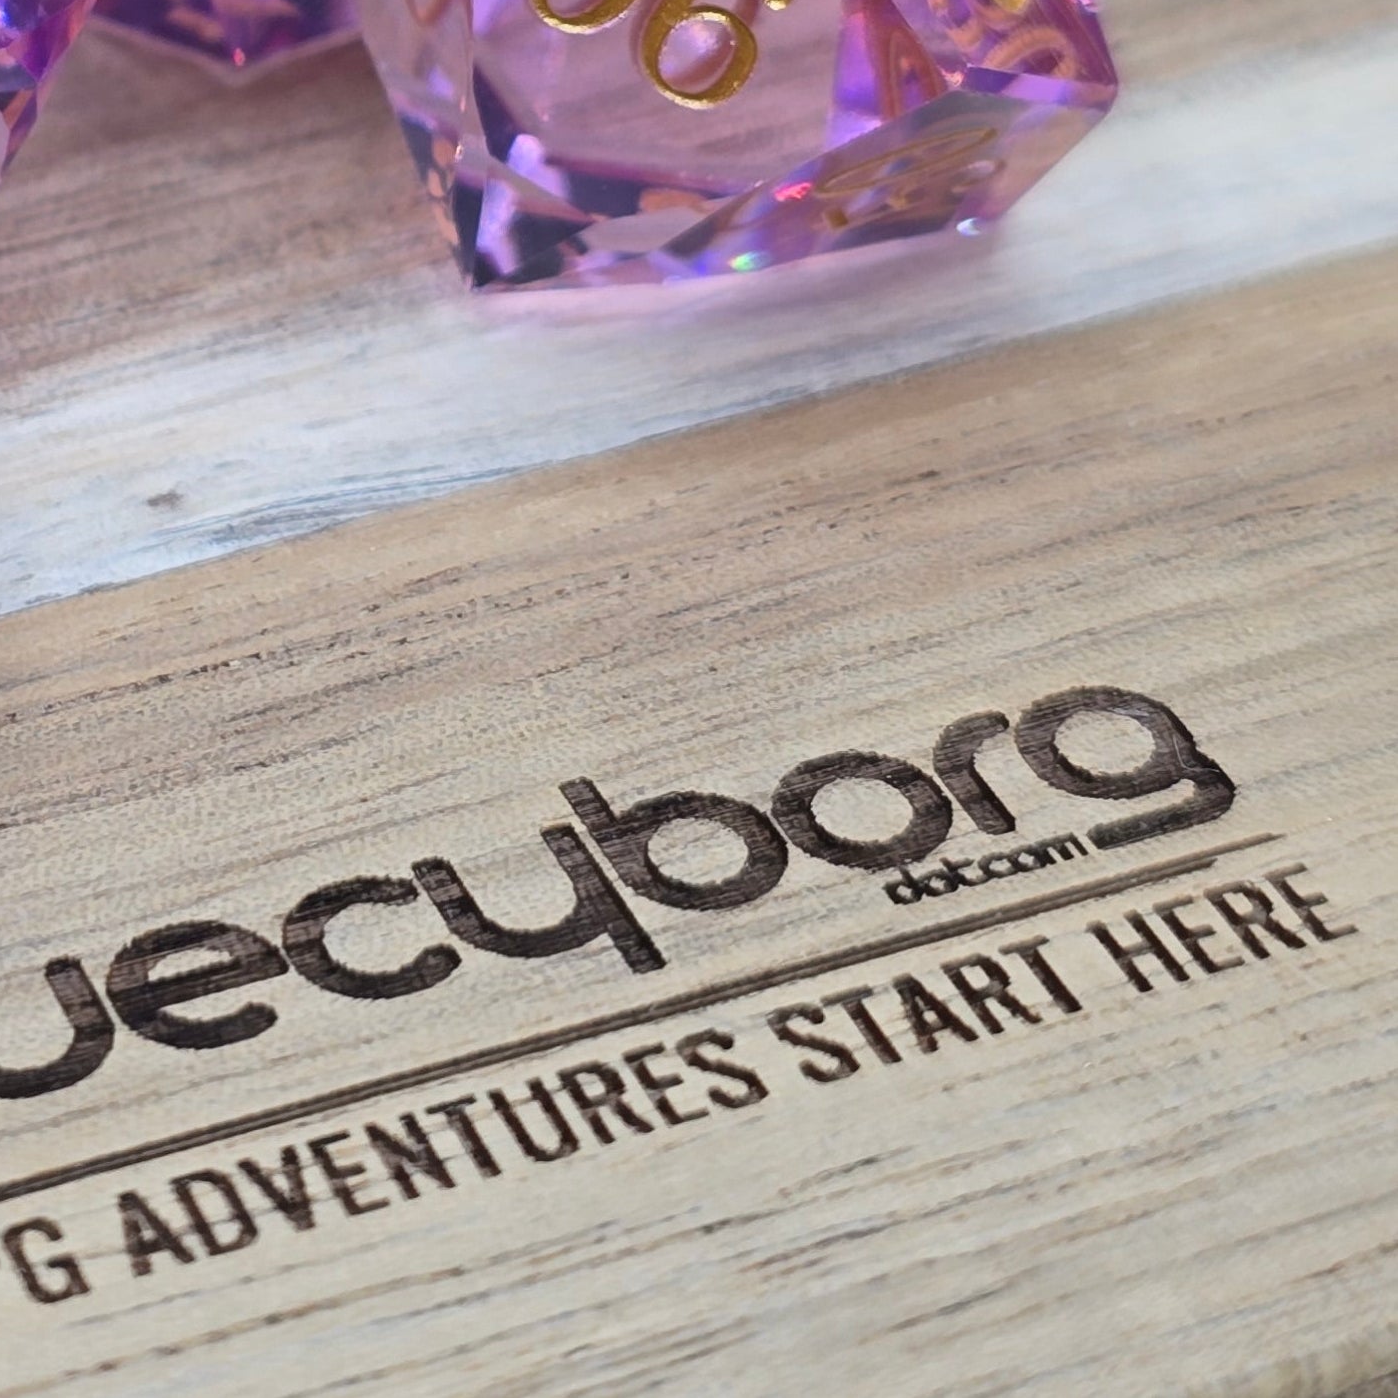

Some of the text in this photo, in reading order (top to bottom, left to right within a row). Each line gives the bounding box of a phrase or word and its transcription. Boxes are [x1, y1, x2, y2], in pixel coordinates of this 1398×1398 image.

[883, 832, 1089, 906] dotcom
[117, 1028, 768, 1277] ADVENTURES
[767, 935, 1083, 1083] START
[1086, 863, 1358, 993] HERE
